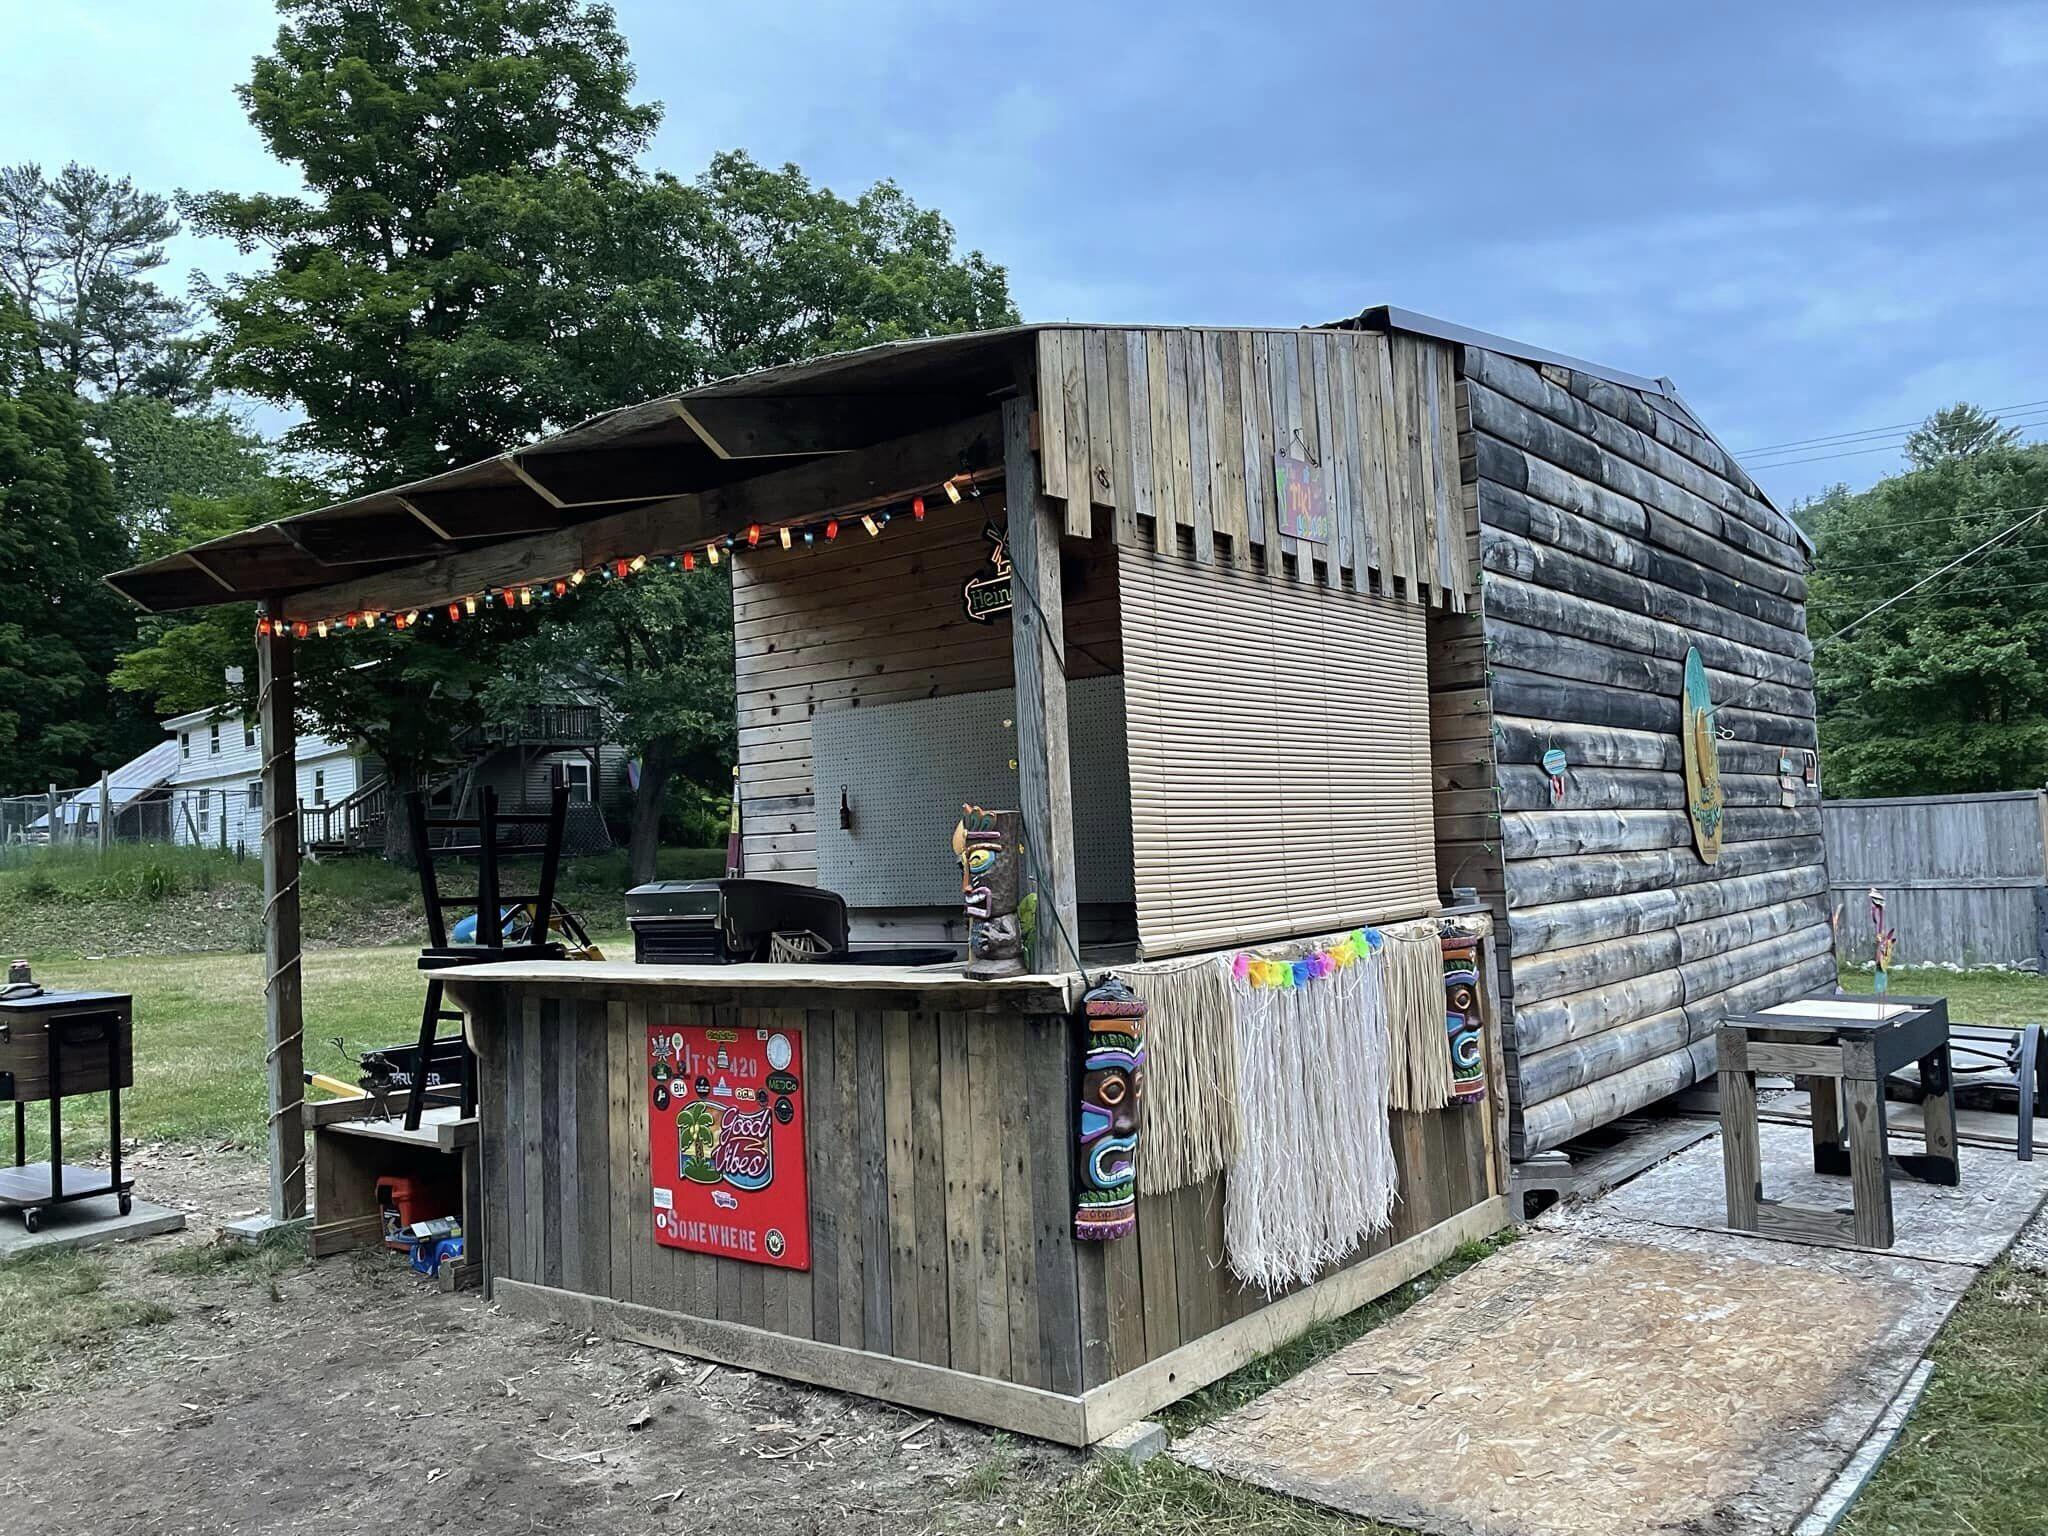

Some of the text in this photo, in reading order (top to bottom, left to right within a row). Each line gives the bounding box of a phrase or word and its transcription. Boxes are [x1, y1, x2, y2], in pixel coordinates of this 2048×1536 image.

[970, 587, 1012, 610] Hein
[686, 1044, 716, 1076] IT'S
[730, 1056, 757, 1078] 420
[389, 1072, 440, 1085] TRUER
[673, 1083, 685, 1093] BH
[721, 1107, 769, 1146] Good
[712, 1142, 767, 1176] Vibes
[667, 1210, 757, 1252] SOMEWHERE
